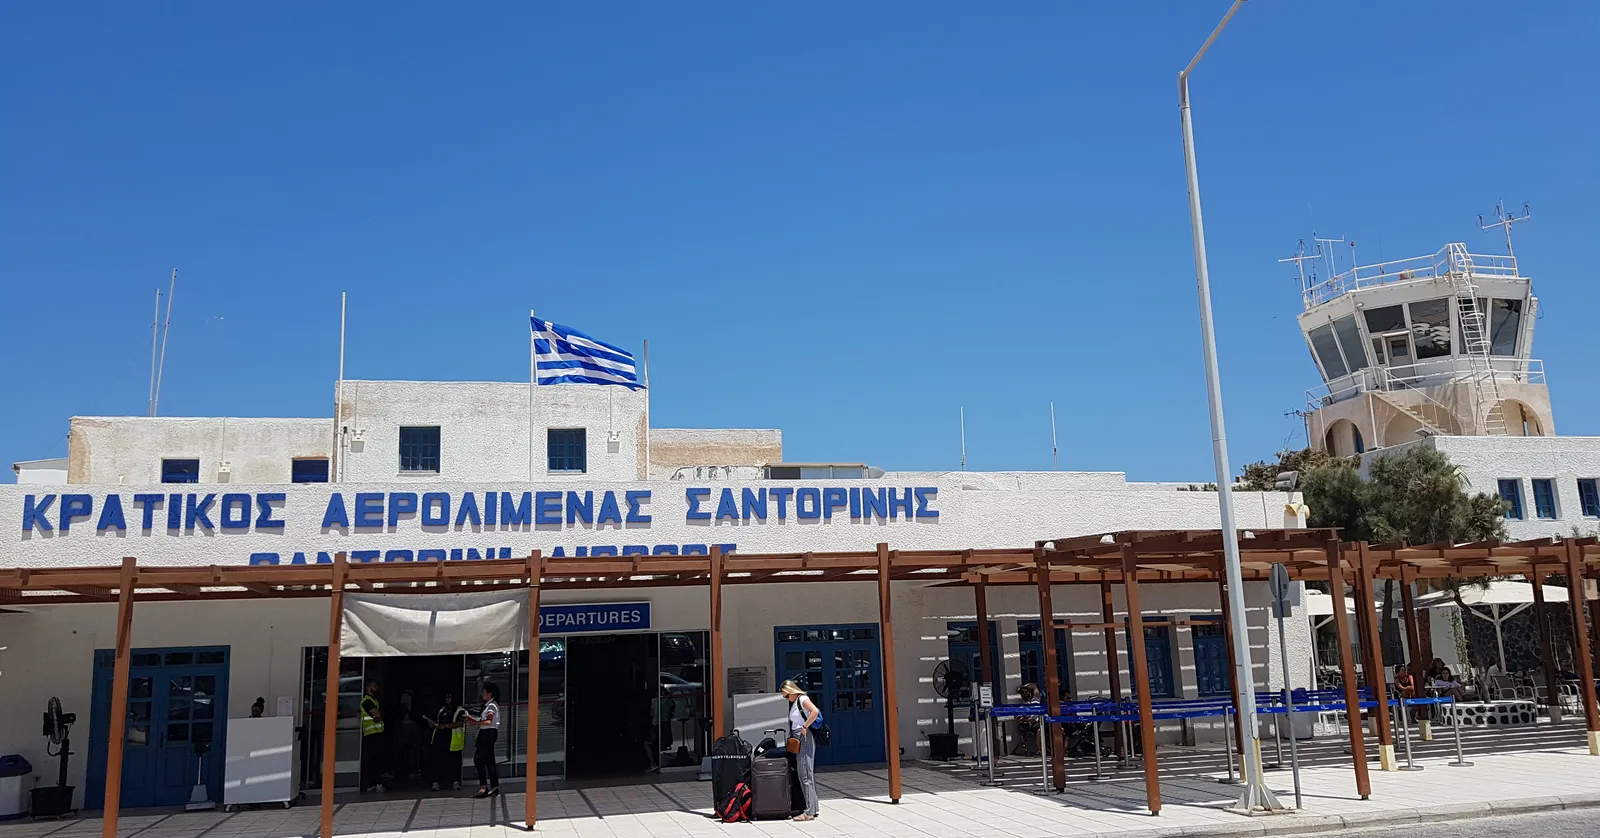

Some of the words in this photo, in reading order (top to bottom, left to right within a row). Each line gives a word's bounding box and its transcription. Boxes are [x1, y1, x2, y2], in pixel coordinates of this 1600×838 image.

[23, 493, 286, 530] ΚΡΑΤΙΚΟΣ
[322, 490, 652, 527] ΑΕΡΟΛΙΜΕΝΑΣ
[686, 487, 939, 519] ΣΑΝΤΟΡΙΝΗΣ
